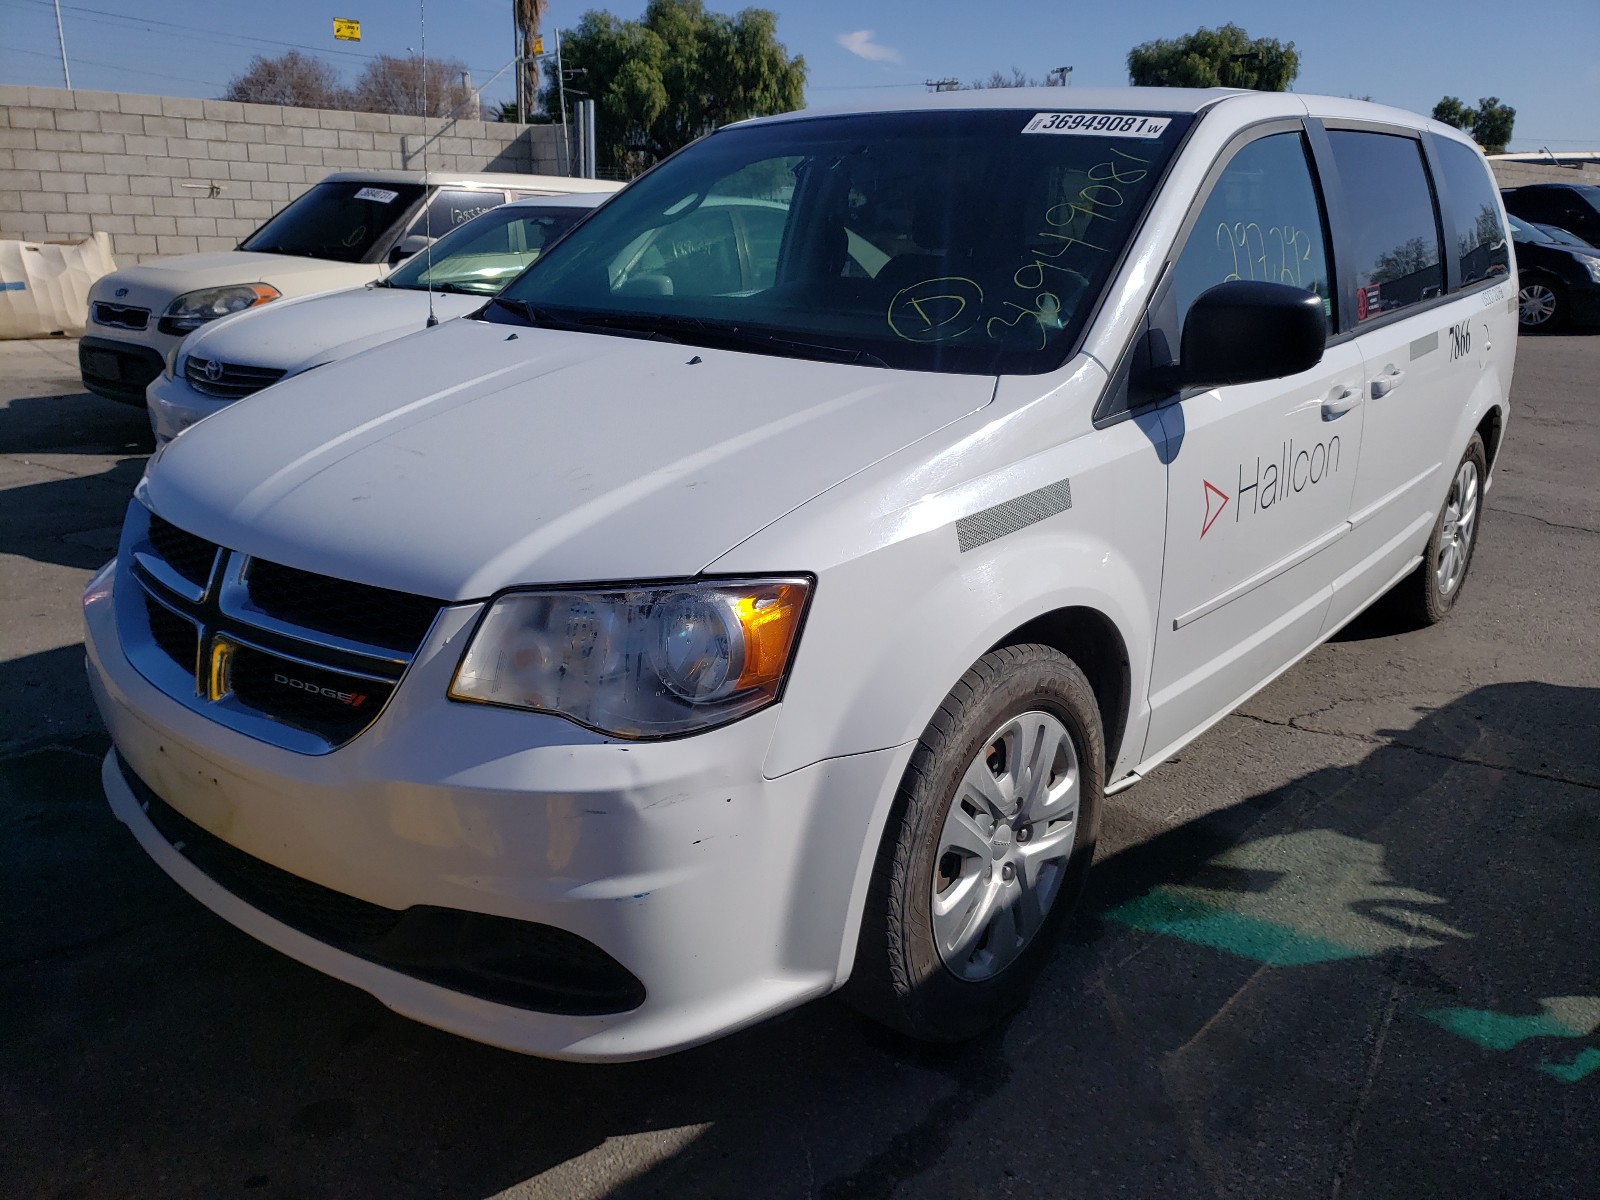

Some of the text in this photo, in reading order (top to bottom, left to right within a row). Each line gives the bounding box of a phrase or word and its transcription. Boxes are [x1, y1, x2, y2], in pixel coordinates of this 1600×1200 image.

[1043, 115, 1149, 132] 36949081
[1449, 318, 1471, 362] 7866
[1236, 435, 1340, 522] Hallcon
[274, 673, 352, 701] DODGE
